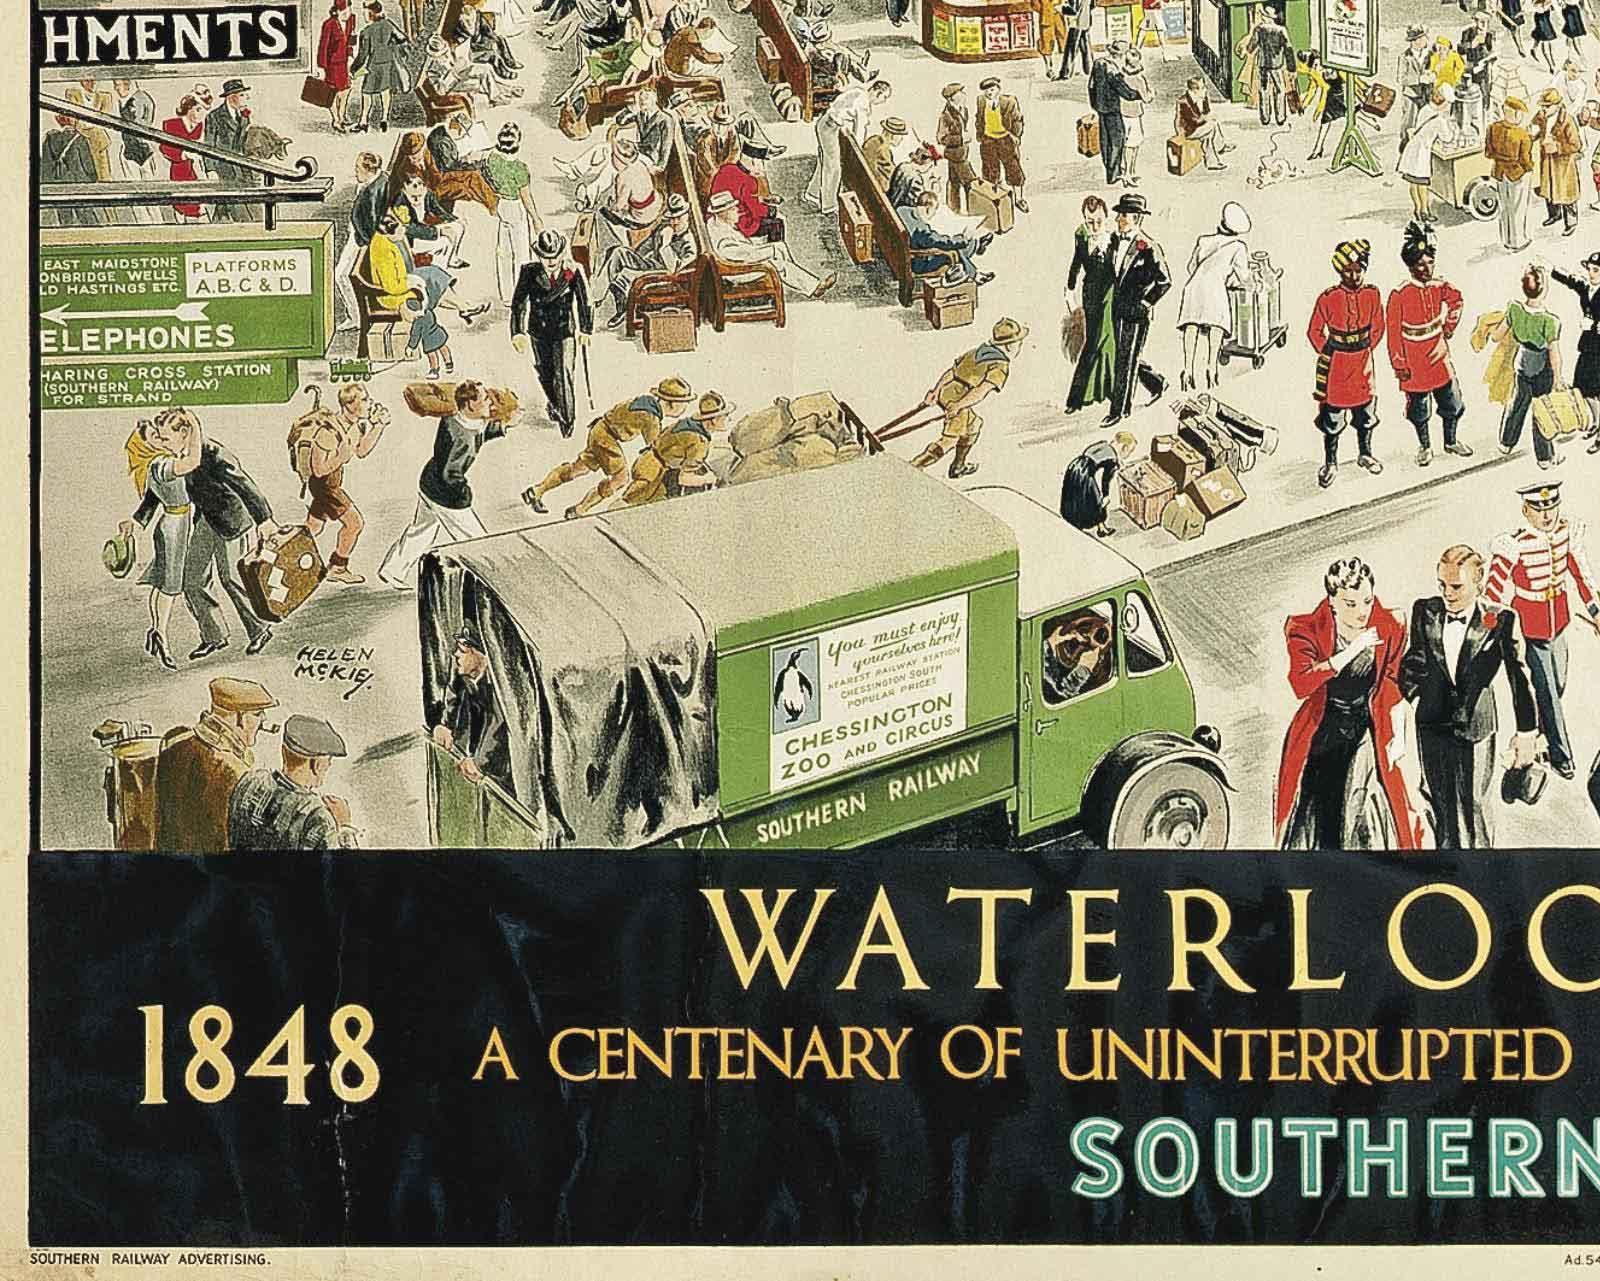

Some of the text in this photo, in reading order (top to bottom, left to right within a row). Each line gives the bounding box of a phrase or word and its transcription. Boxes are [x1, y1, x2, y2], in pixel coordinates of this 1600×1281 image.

[43, 10, 288, 63] HMENTS
[40, 270, 178, 283] ONBRIDGE WELLS
[44, 257, 179, 271] EAST MAIDSTONE
[192, 259, 297, 273] PLATFORMS
[67, 282, 146, 295] HASTINGS
[40, 323, 235, 353] ELEPHONES
[44, 377, 220, 396] (SOUTHERN RAILWAY)
[126, 366, 186, 380] CROSS
[203, 363, 272, 378] STATION
[53, 393, 172, 406] FOR STRAND
[873, 623, 915, 644] must
[920, 609, 960, 632] enjoy
[296, 646, 374, 662] HELEN
[853, 627, 962, 672] yourselves here!
[828, 647, 961, 690] NEAREST RAILWAY STATION
[840, 664, 943, 700] CHESSINGTON SOUTH
[847, 677, 937, 709] POPULAR PRICES
[784, 692, 953, 757] CHESSINGTON
[781, 714, 953, 781] ZOO AND CIRCUS
[757, 751, 982, 843] SOUTHERN RAILWAY
[138, 1004, 380, 1105] 1848
[472, 1026, 519, 1080] A
[549, 1025, 913, 1082] CENTENARY
[940, 1024, 1023, 1081] OF
[1056, 1027, 1573, 1086] UNINTERRUPTED
[30, 1252, 271, 1265] SOUTHERN RAILWAY ADVERTISING.
